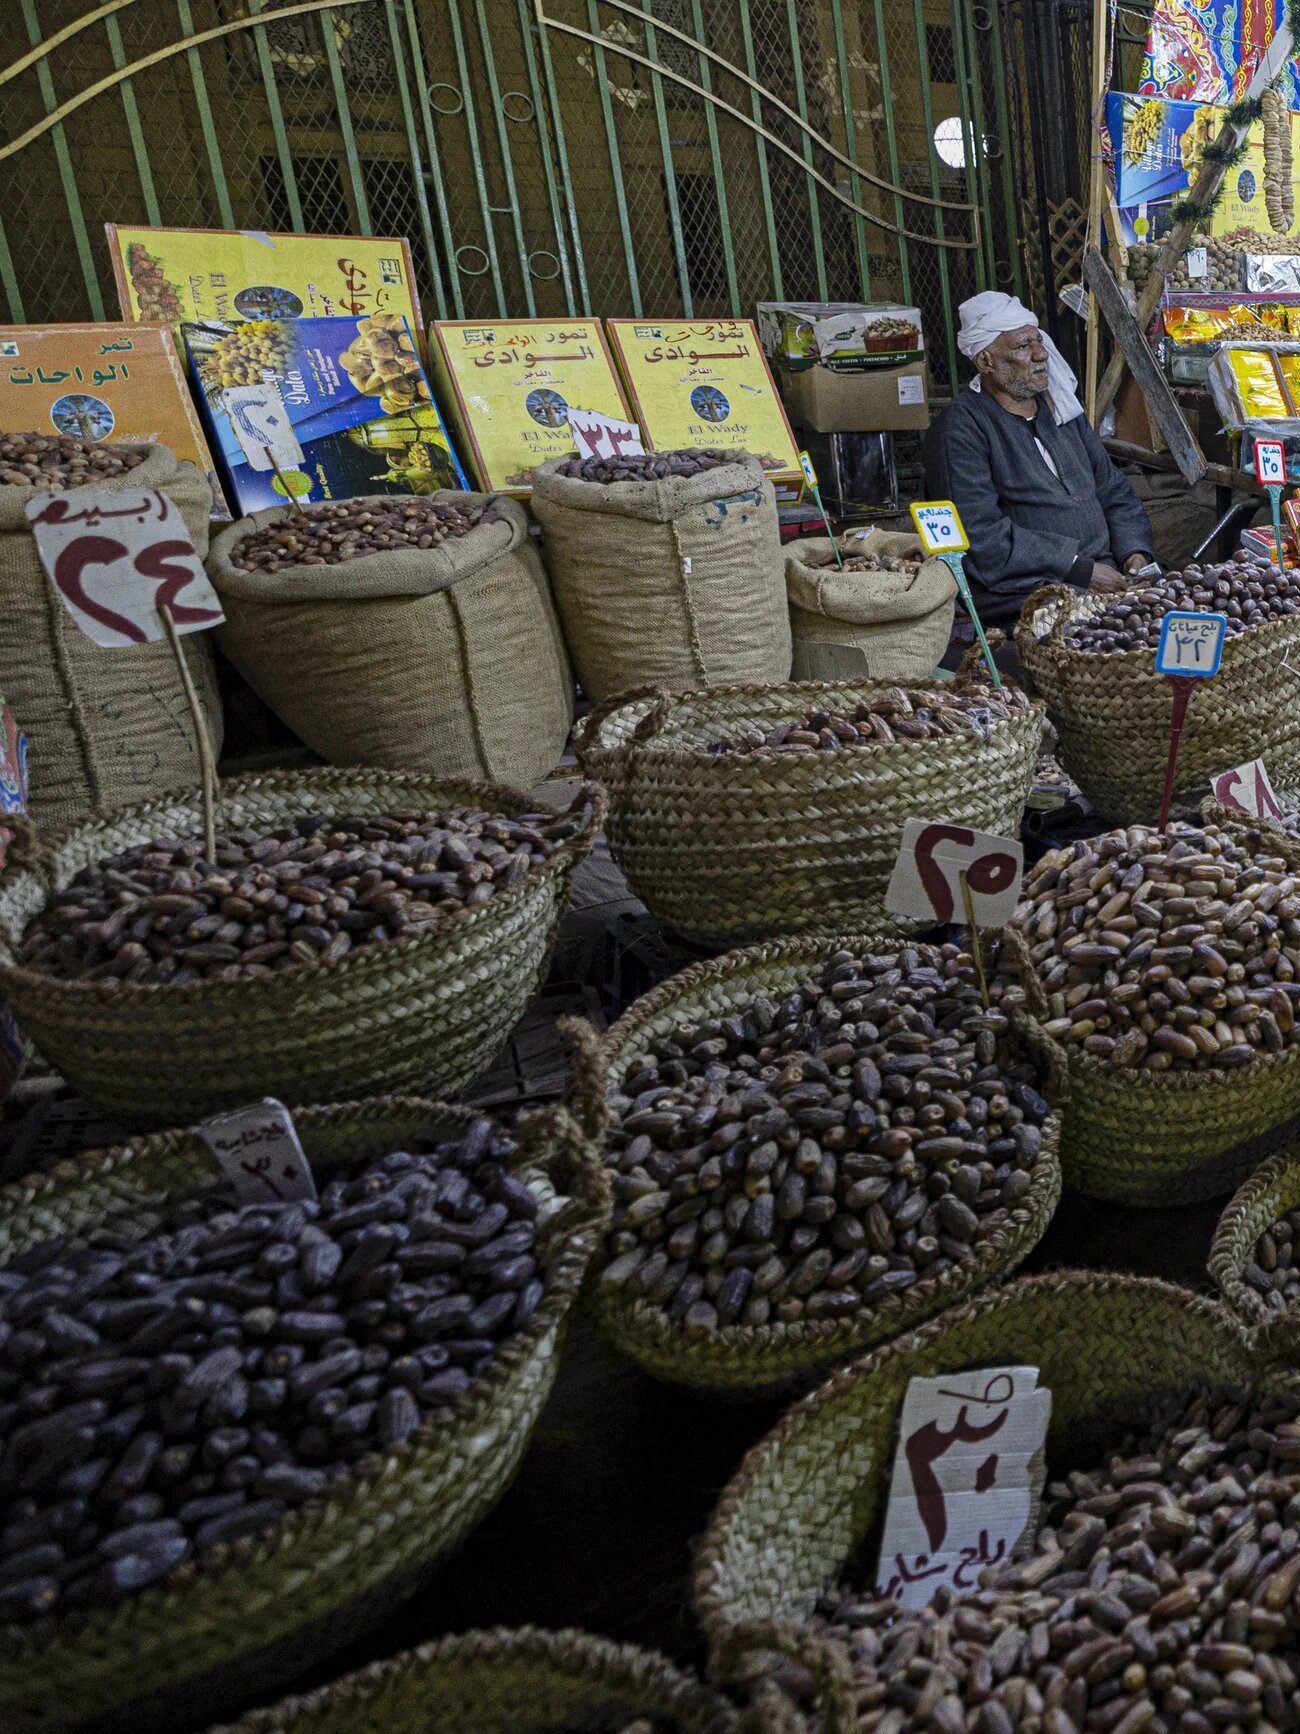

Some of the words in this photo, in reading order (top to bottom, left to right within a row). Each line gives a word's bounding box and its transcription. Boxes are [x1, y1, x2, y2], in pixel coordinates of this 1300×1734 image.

[98, 337, 134, 355] تمر
[546, 328, 588, 344] تمور
[707, 328, 744, 343] تمور
[8, 363, 130, 387] الواحات
[284, 371, 311, 405] Dates
[231, 400, 280, 446] ٢٠
[687, 426, 703, 434] El
[707, 424, 749, 434] Wady
[522, 431, 539, 441] El
[543, 431, 571, 441] Wa
[1263, 455, 1278, 476] ٣٥
[926, 522, 951, 543] ٣٥
[54, 535, 224, 643] ٢٤
[914, 824, 1017, 924] ٢٥
[905, 1404, 1009, 1554] ٣٠
